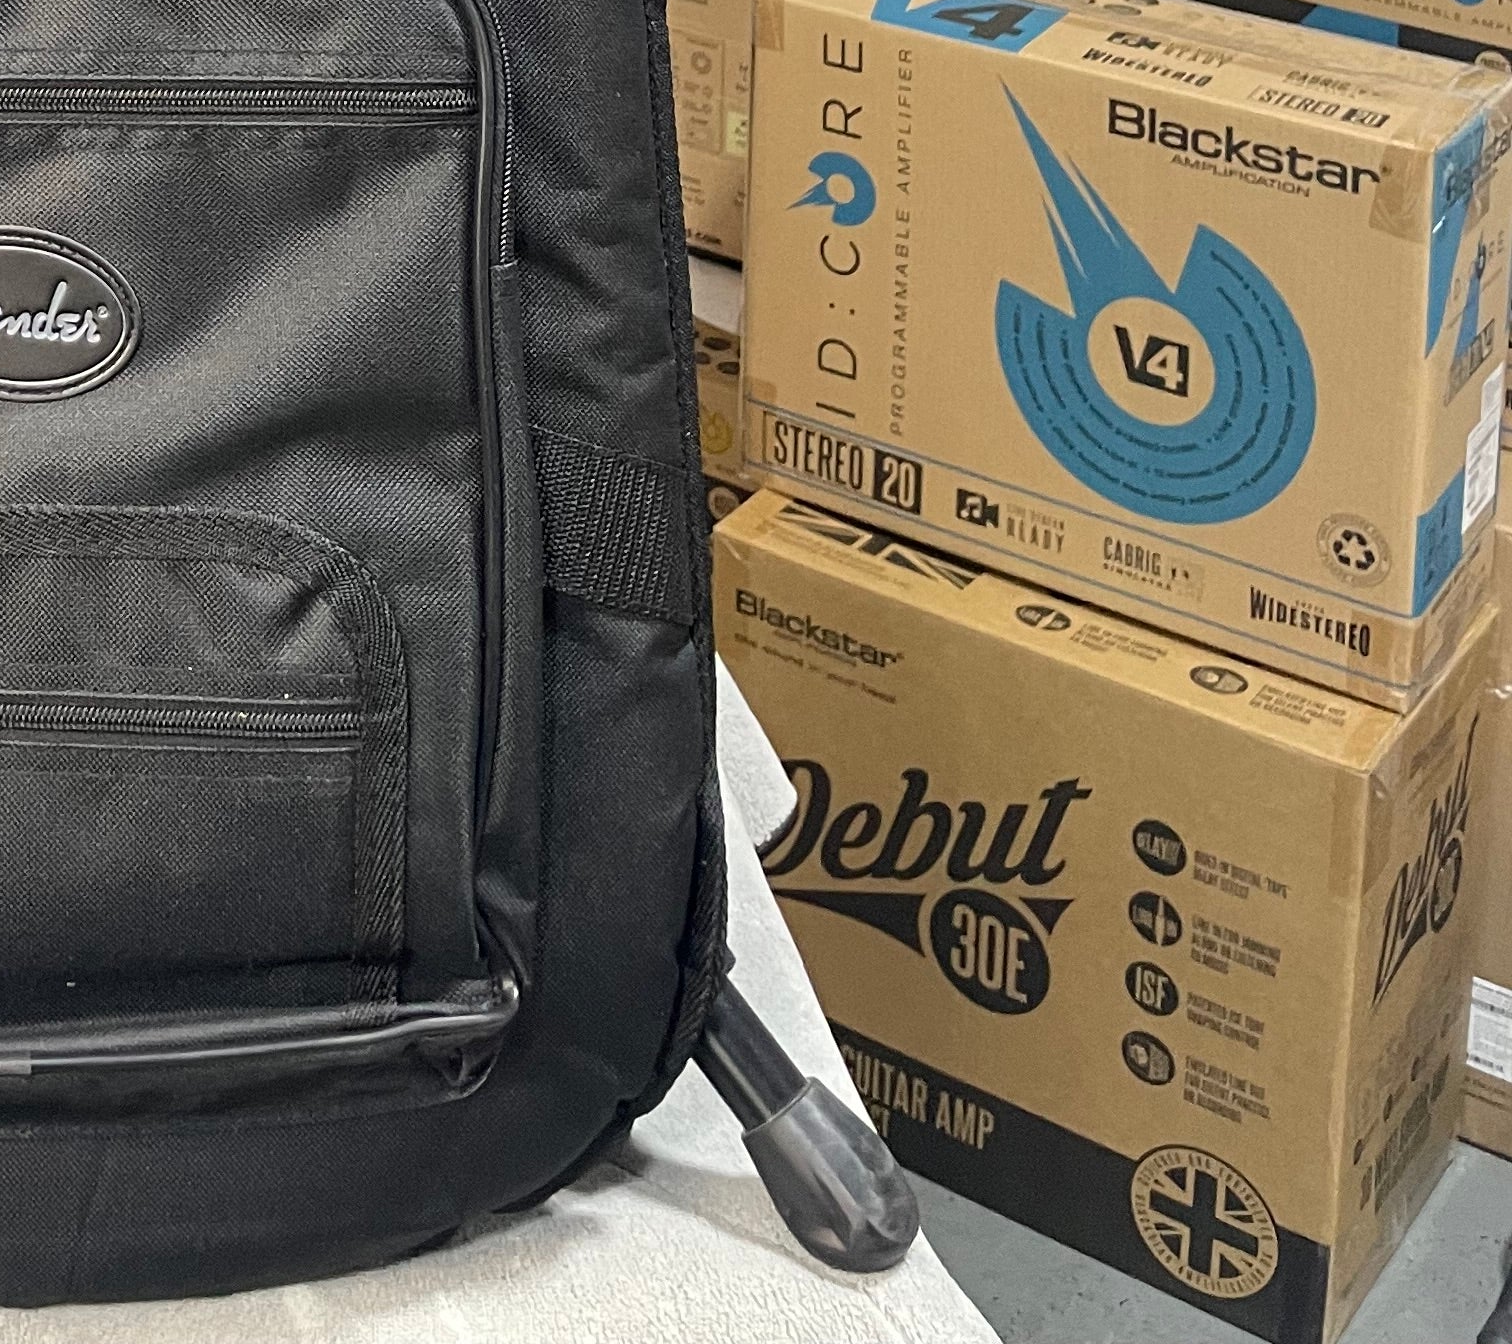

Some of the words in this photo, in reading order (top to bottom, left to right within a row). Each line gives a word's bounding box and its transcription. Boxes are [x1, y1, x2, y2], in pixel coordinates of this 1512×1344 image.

[895, 47, 914, 194] AMPLIFIER
[1107, 96, 1381, 195] Blackstar
[1170, 153, 1310, 199] AMPLIFICATION
[890, 208, 912, 437] PROGRAMMABLE
[1113, 323, 1190, 398] V4
[773, 420, 864, 491] STEREO
[881, 455, 916, 509] 20
[735, 587, 899, 668] Blackstar
[1250, 585, 1371, 657] WIDESTEREO
[759, 758, 1093, 886] Debut
[949, 902, 1030, 1004] 30E
[1135, 966, 1169, 1011] ISF
[936, 1090, 996, 1150] AMP
